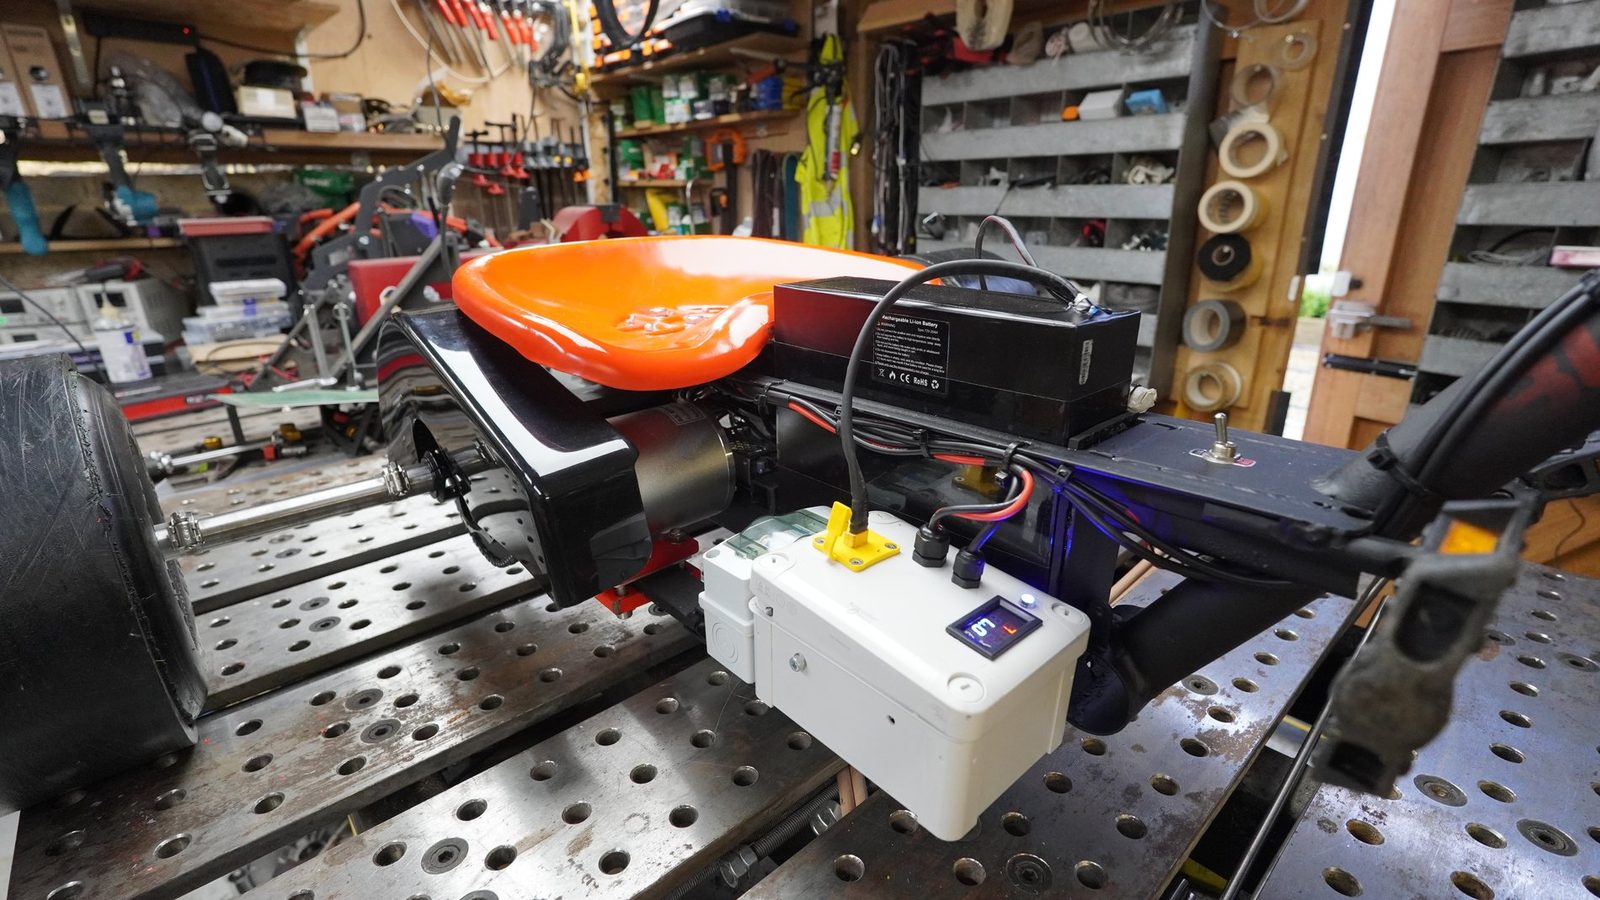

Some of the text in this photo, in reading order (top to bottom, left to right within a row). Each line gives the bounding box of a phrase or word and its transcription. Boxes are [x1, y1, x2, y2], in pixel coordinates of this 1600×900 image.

[882, 315, 909, 323] Rechargeable
[922, 321, 938, 329] Battery
[900, 373, 928, 387] CE RoHS
